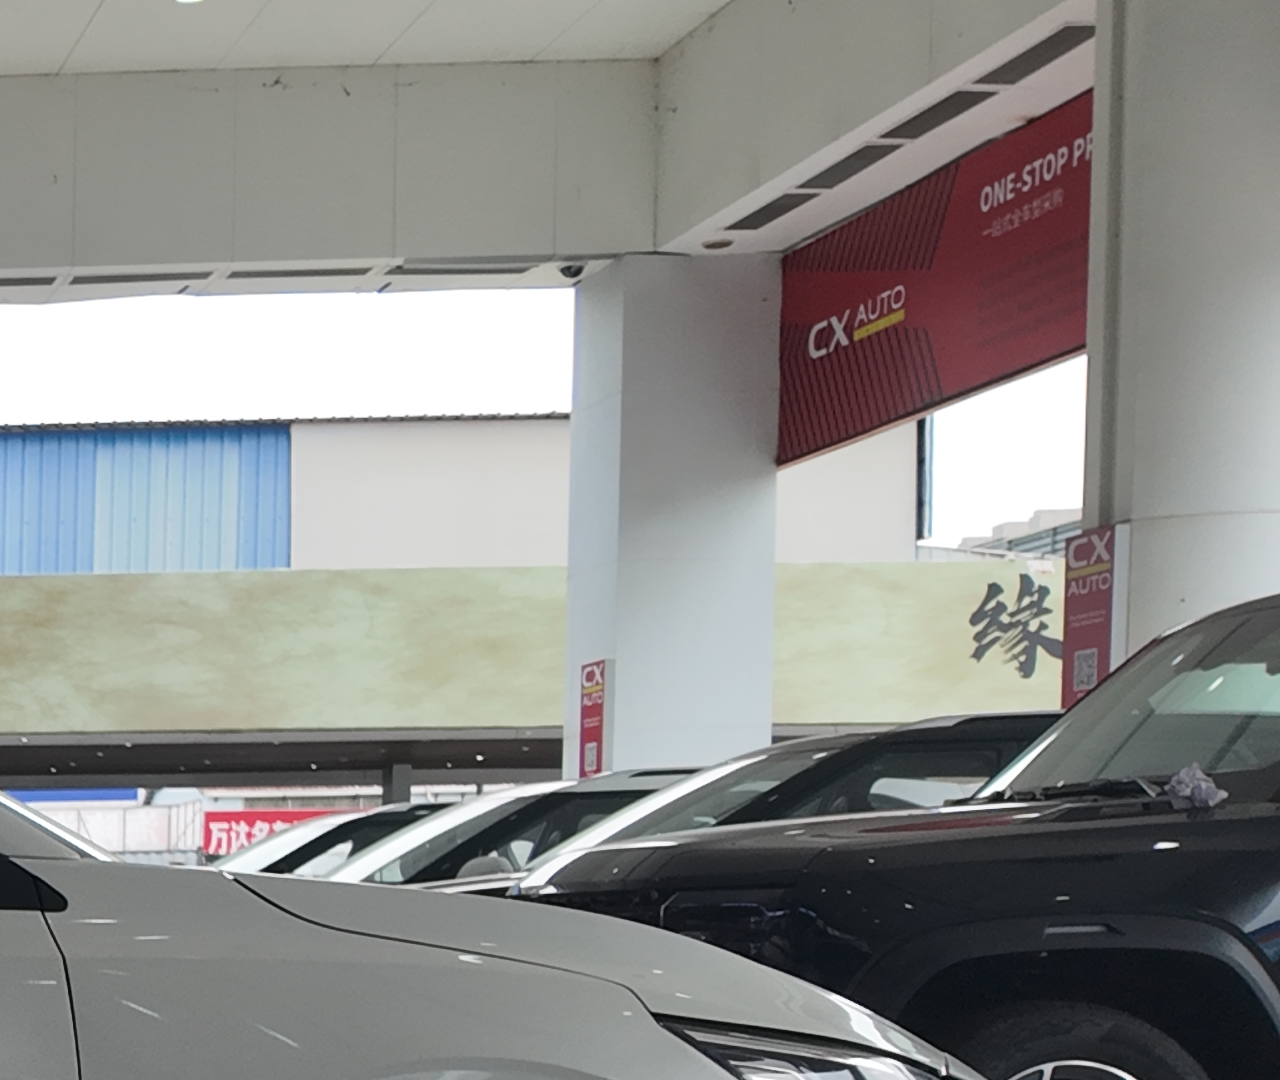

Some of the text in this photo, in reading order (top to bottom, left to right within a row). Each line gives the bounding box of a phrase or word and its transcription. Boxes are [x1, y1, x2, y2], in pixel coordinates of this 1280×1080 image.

[980, 146, 1068, 213] ONE-STOP
[808, 284, 906, 359] CX AUTO
[1067, 530, 1112, 568] CX
[1067, 572, 1111, 597] AUTO
[582, 663, 604, 688] CX
[582, 690, 603, 706] AUTO
[209, 819, 300, 855] 万达名
